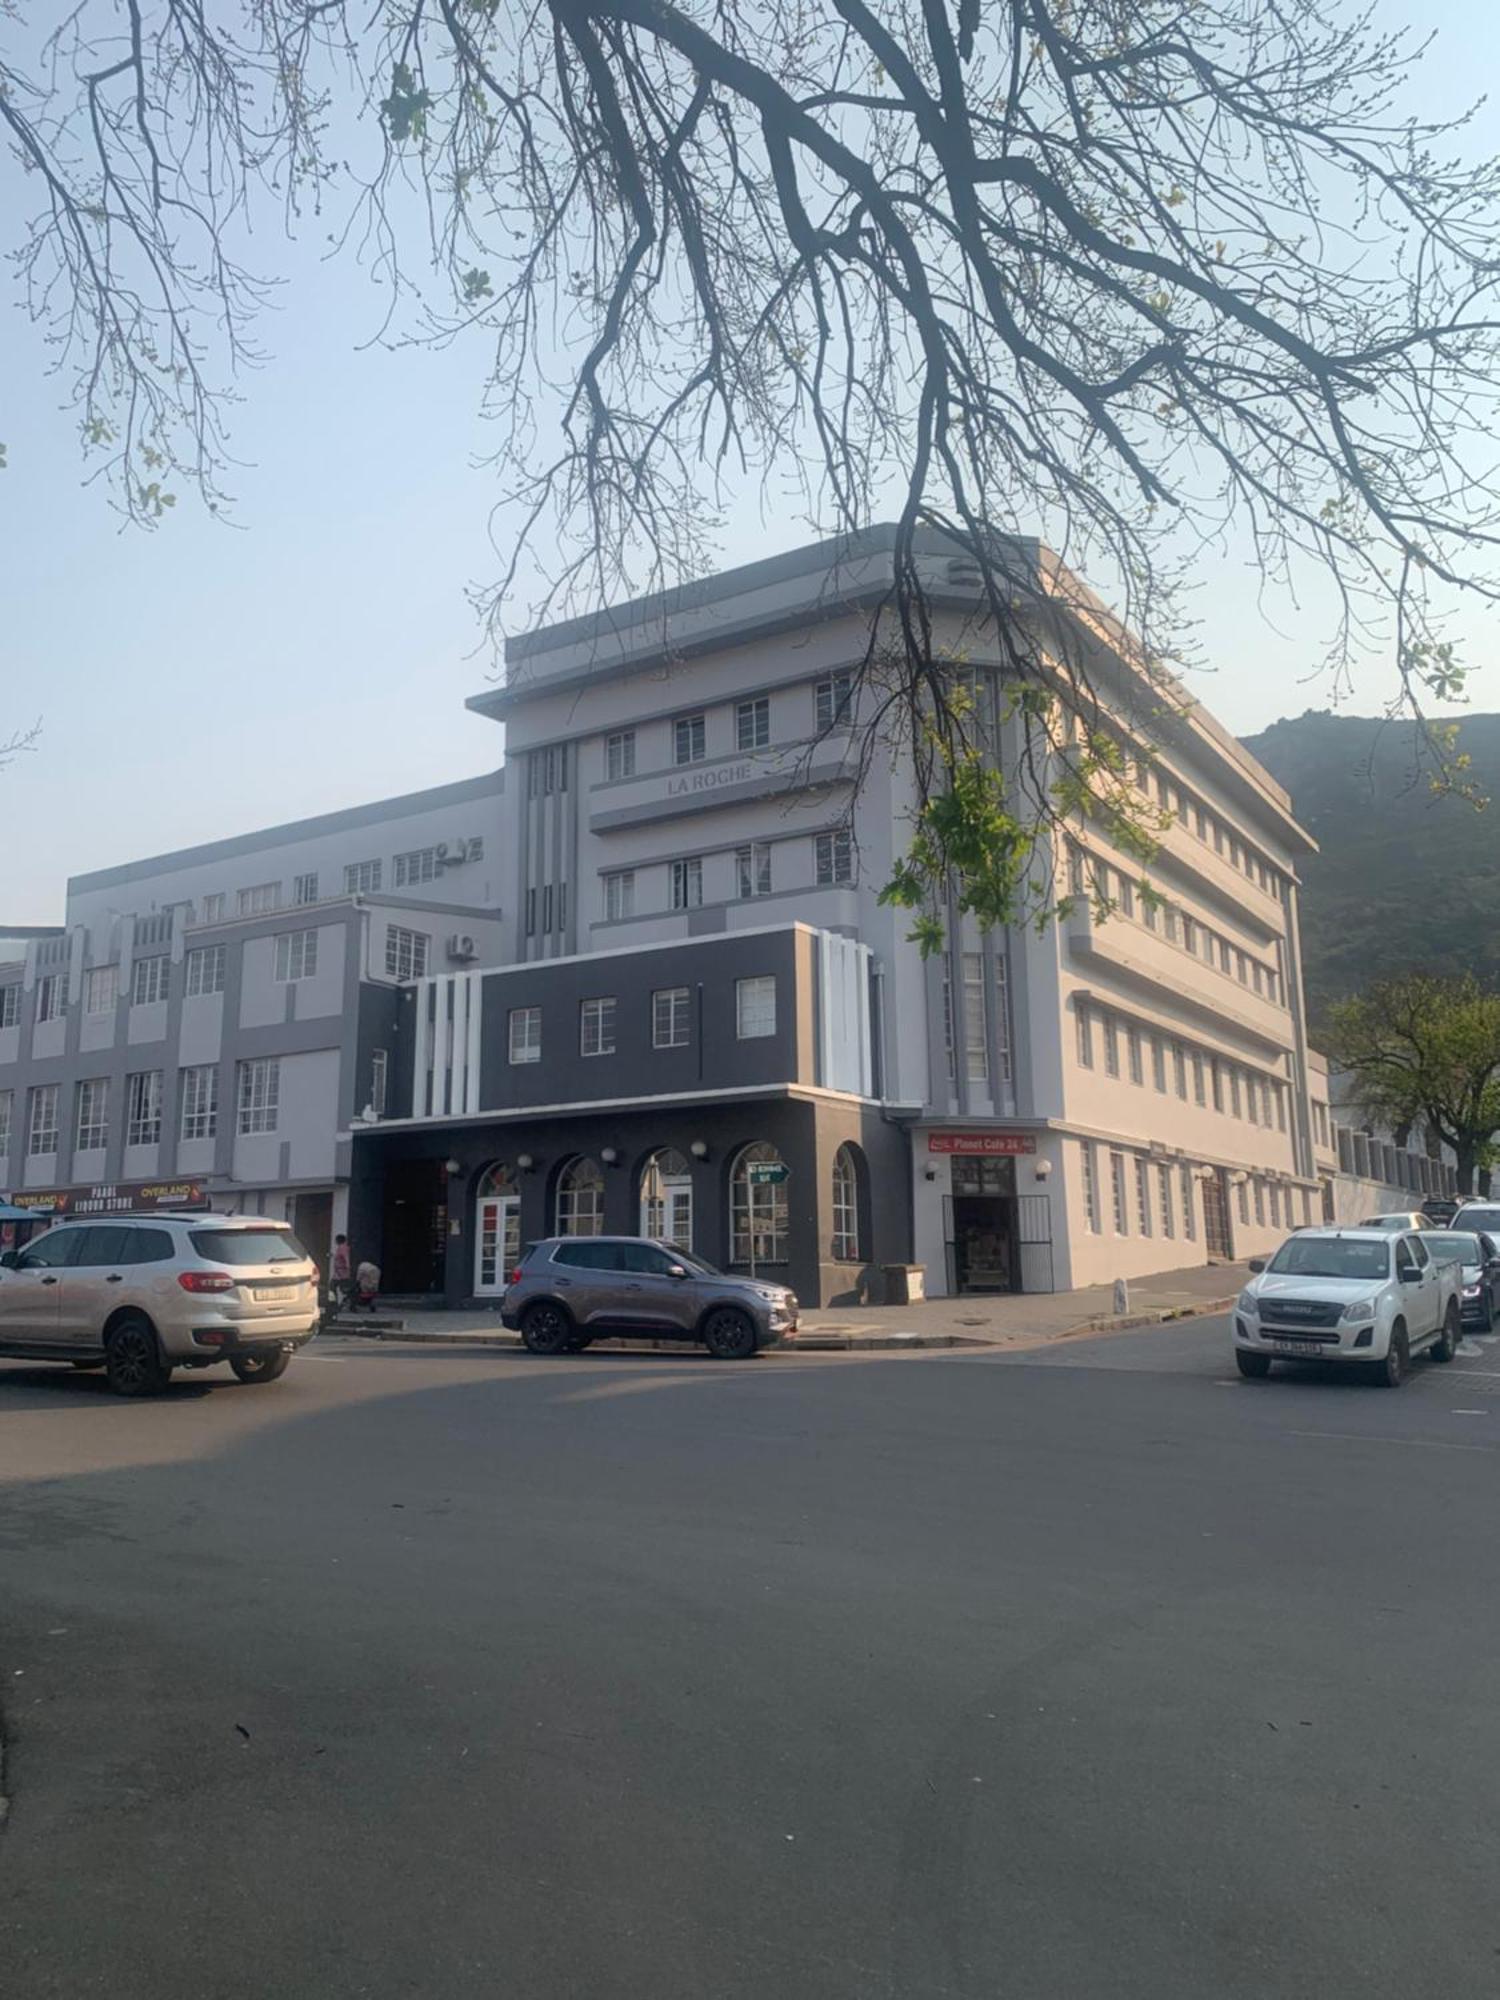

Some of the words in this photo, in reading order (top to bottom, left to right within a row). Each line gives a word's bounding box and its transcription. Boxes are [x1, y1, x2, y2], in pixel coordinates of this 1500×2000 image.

[668, 780, 689, 796] LA
[693, 765, 751, 791] ROCHE
[140, 1184, 191, 1198] OVERLAND
[14, 1195, 58, 1206] OVERLAND
[74, 1199, 104, 1213] LIQUOR
[106, 1197, 133, 1210] STORE
